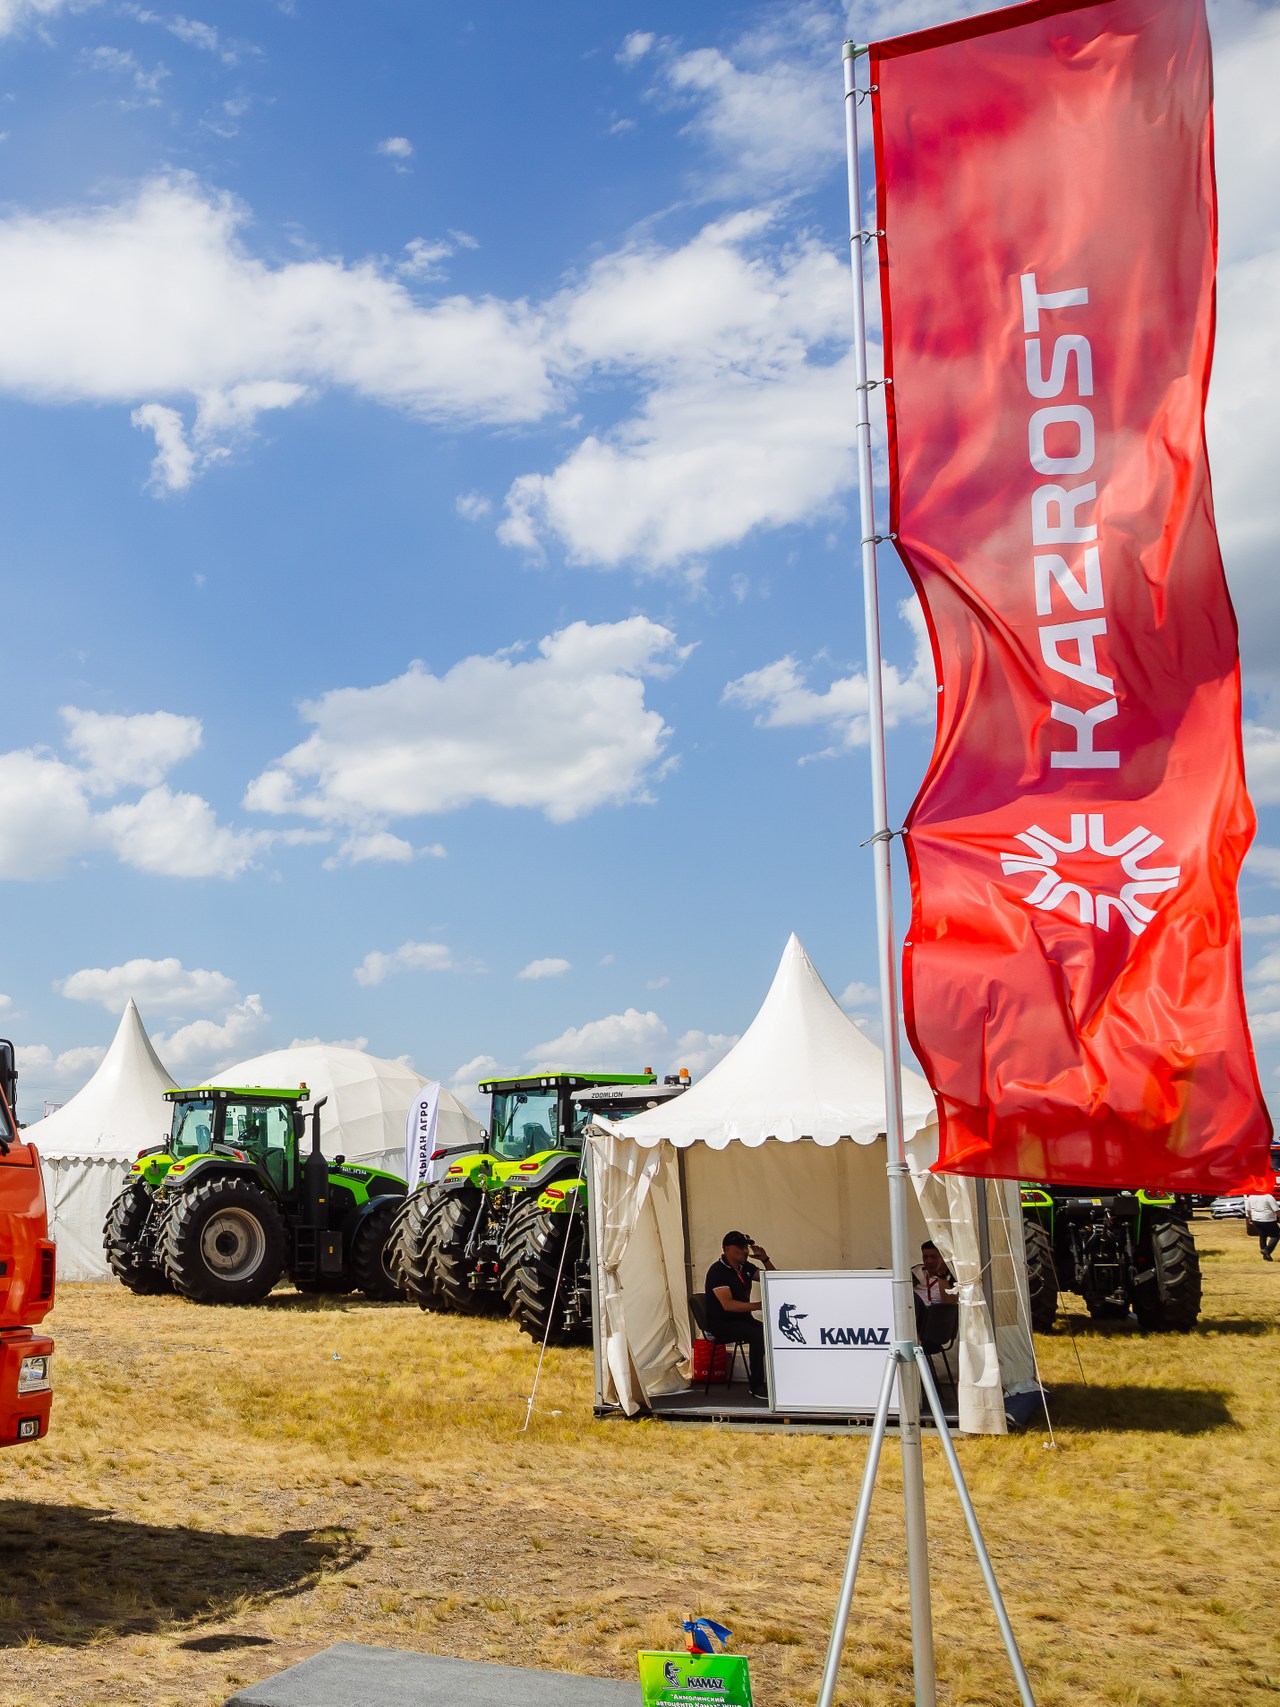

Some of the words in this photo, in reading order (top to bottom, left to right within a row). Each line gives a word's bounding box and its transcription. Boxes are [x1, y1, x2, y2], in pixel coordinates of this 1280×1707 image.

[1020, 272, 1120, 769] KAZROST
[591, 1091, 624, 1099] ZOOMLION
[420, 1101, 429, 1131] АГРО
[820, 1327, 891, 1345] KAMAZ
[686, 1676, 725, 1689] KAMAZ
